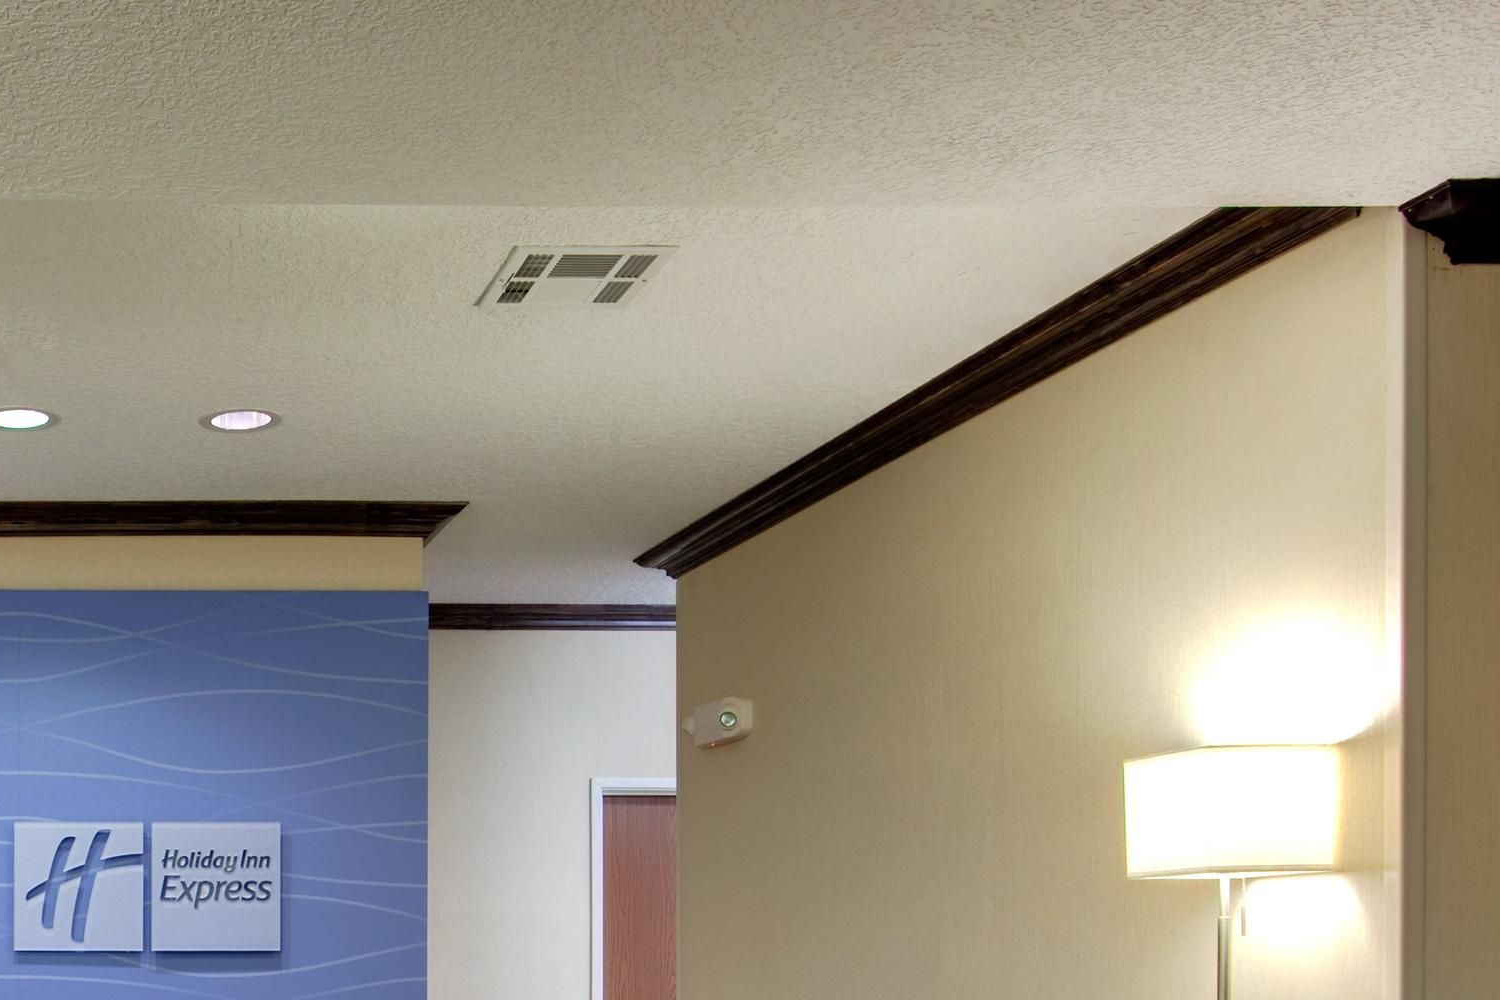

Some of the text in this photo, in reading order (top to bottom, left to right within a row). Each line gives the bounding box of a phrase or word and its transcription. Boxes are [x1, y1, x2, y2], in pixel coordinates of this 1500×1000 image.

[162, 849, 271, 873] Holiday Inn
[160, 875, 273, 909] Express
